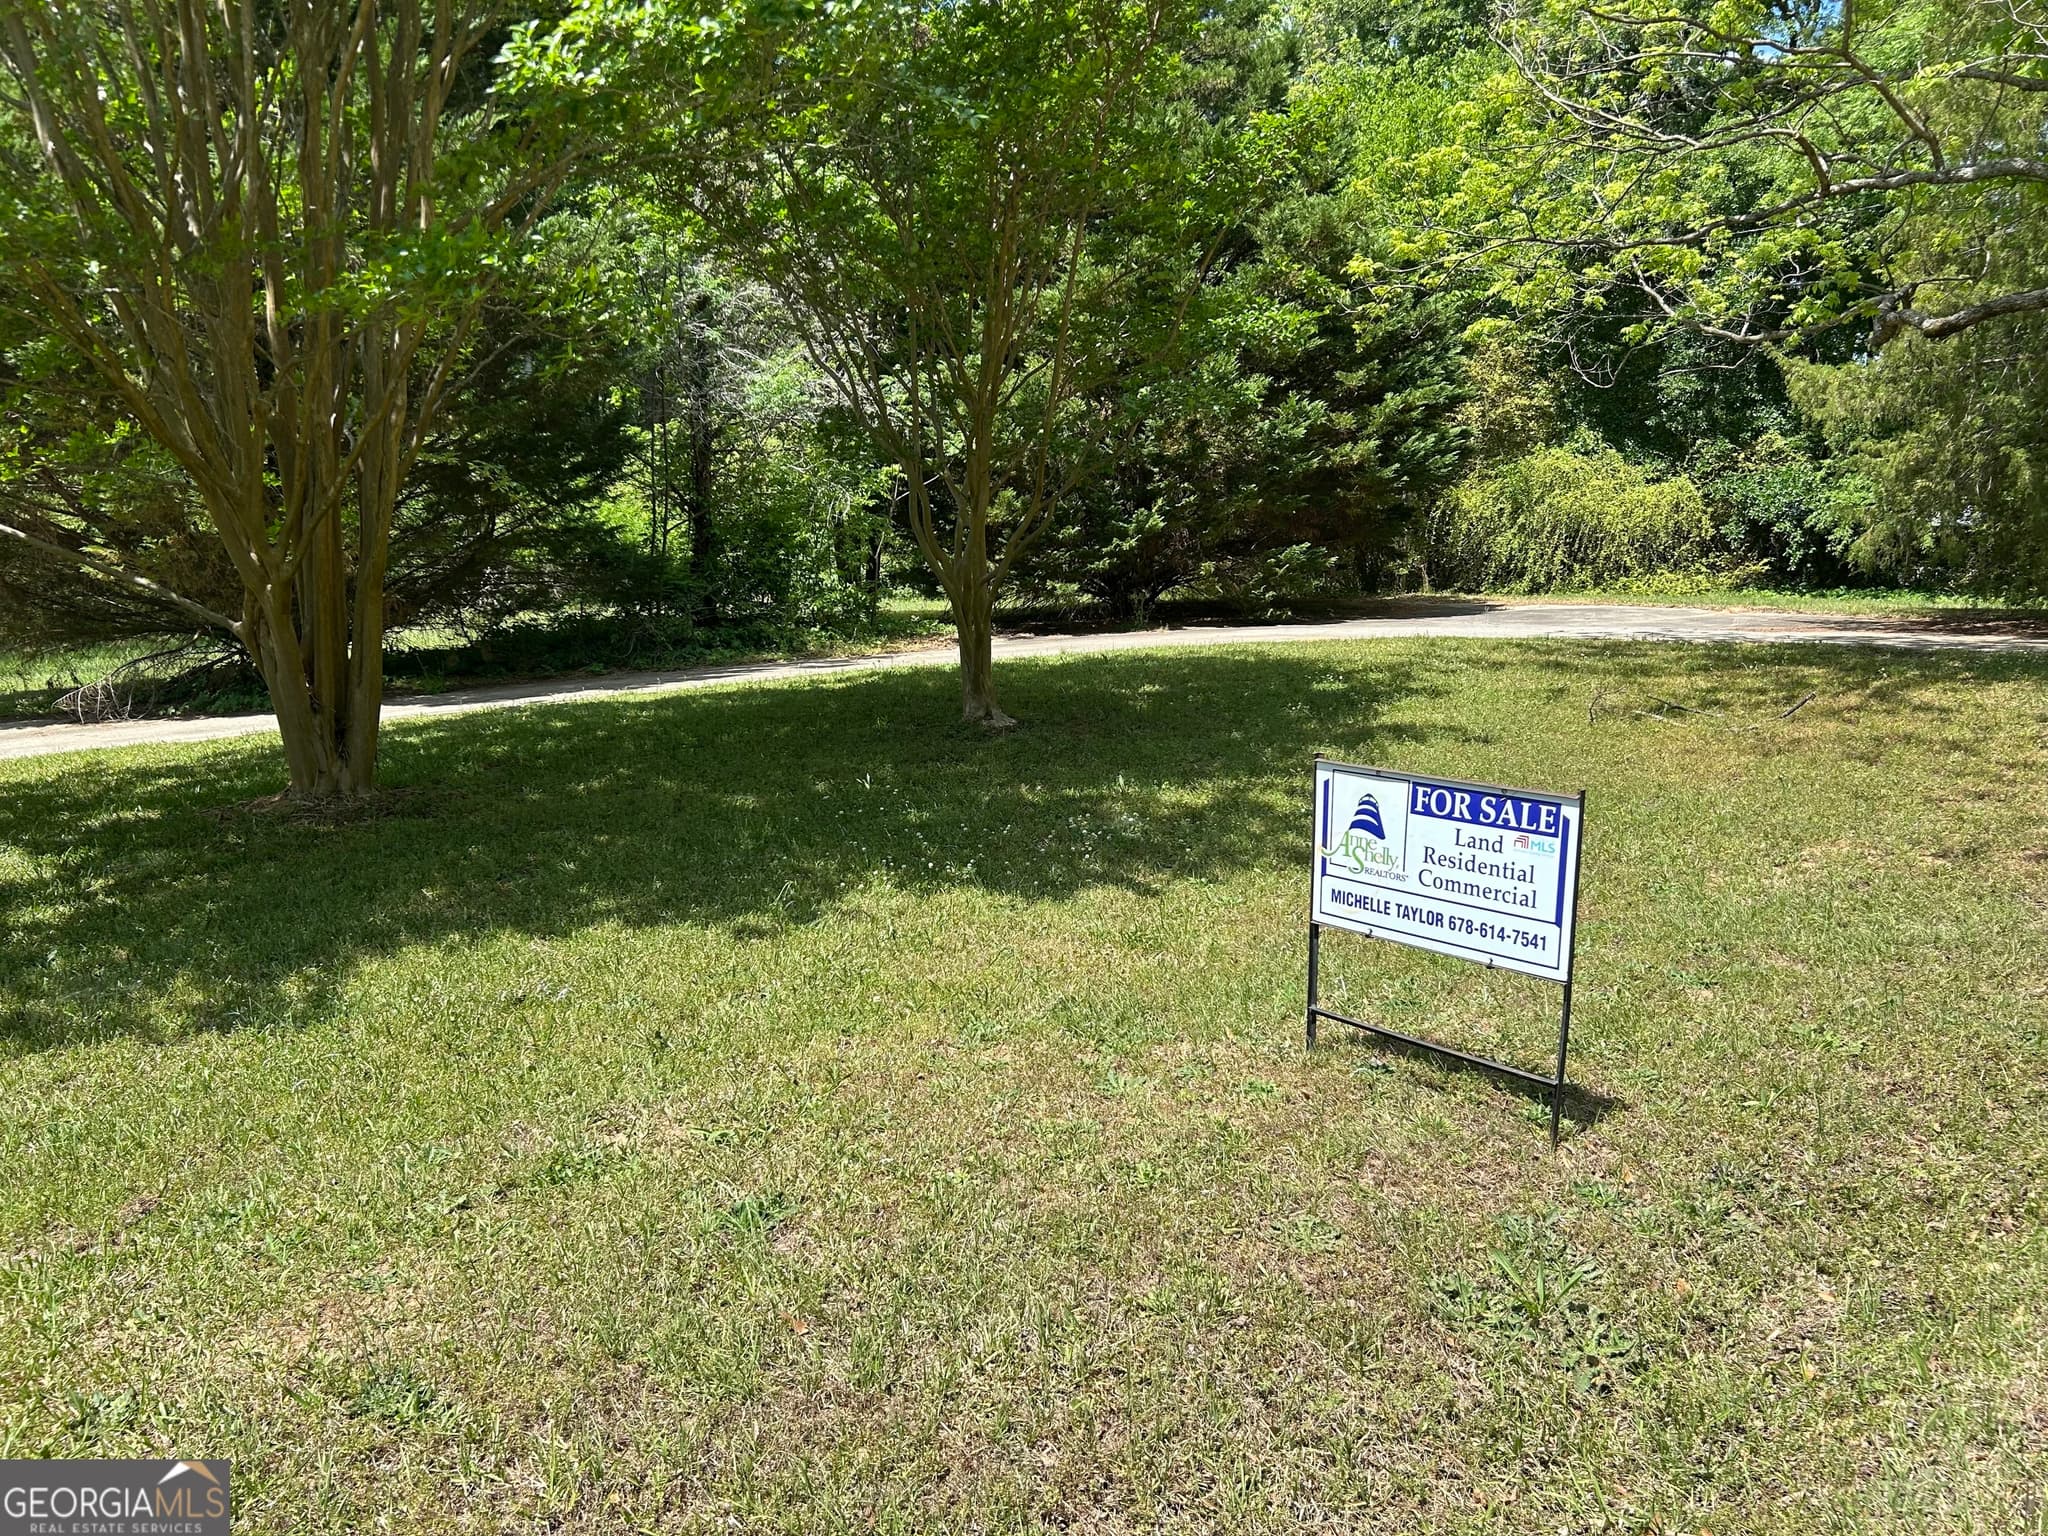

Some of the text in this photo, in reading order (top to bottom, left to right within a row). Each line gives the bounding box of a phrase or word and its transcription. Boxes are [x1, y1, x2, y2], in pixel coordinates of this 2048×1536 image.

[1414, 786, 1558, 834] FOR SALE
[1321, 830, 1378, 857] Anne
[1454, 828, 1504, 853] Land
[1530, 839, 1556, 854] MLS
[1422, 845, 1536, 884] Residential
[1418, 869, 1537, 909] Commercial
[1331, 888, 1547, 951] MICHELLE TAYLOR 678-614-7541
